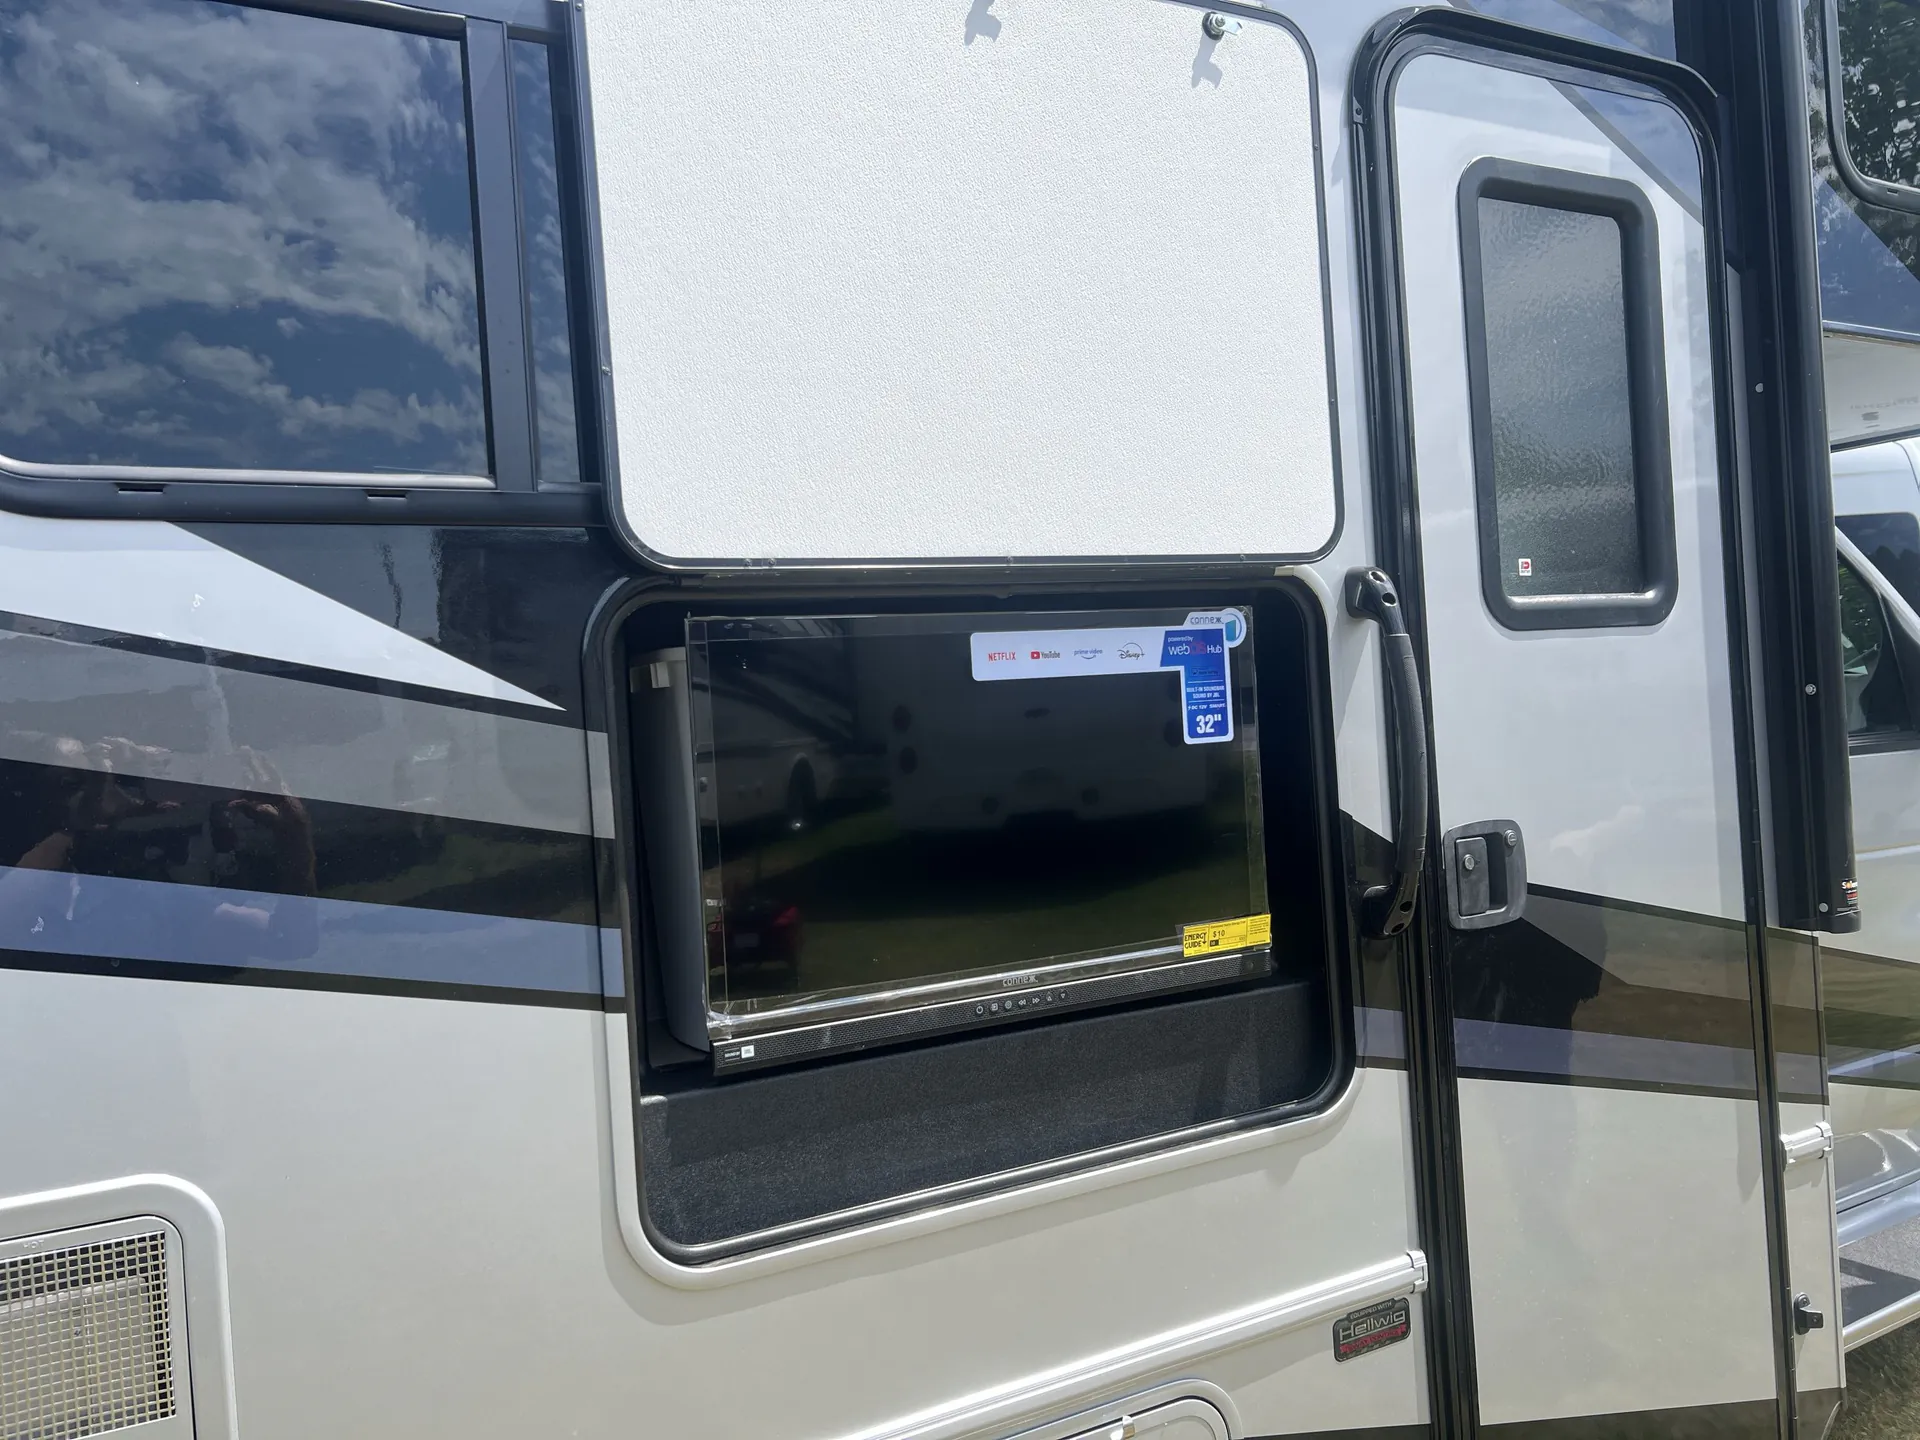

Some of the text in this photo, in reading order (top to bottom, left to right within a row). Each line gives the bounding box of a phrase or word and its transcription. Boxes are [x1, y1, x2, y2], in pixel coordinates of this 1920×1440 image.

[1207, 644, 1222, 654] Hub
[988, 651, 1016, 662] NETFLIX
[1041, 650, 1061, 659] YouTube
[1196, 713, 1222, 734] 32"
[1184, 932, 1207, 942] ENERGY
[1184, 940, 1202, 949] GUIDE
[1350, 1301, 1392, 1320] EQUIPPED WITH
[1339, 1310, 1406, 1341] Hellwig
